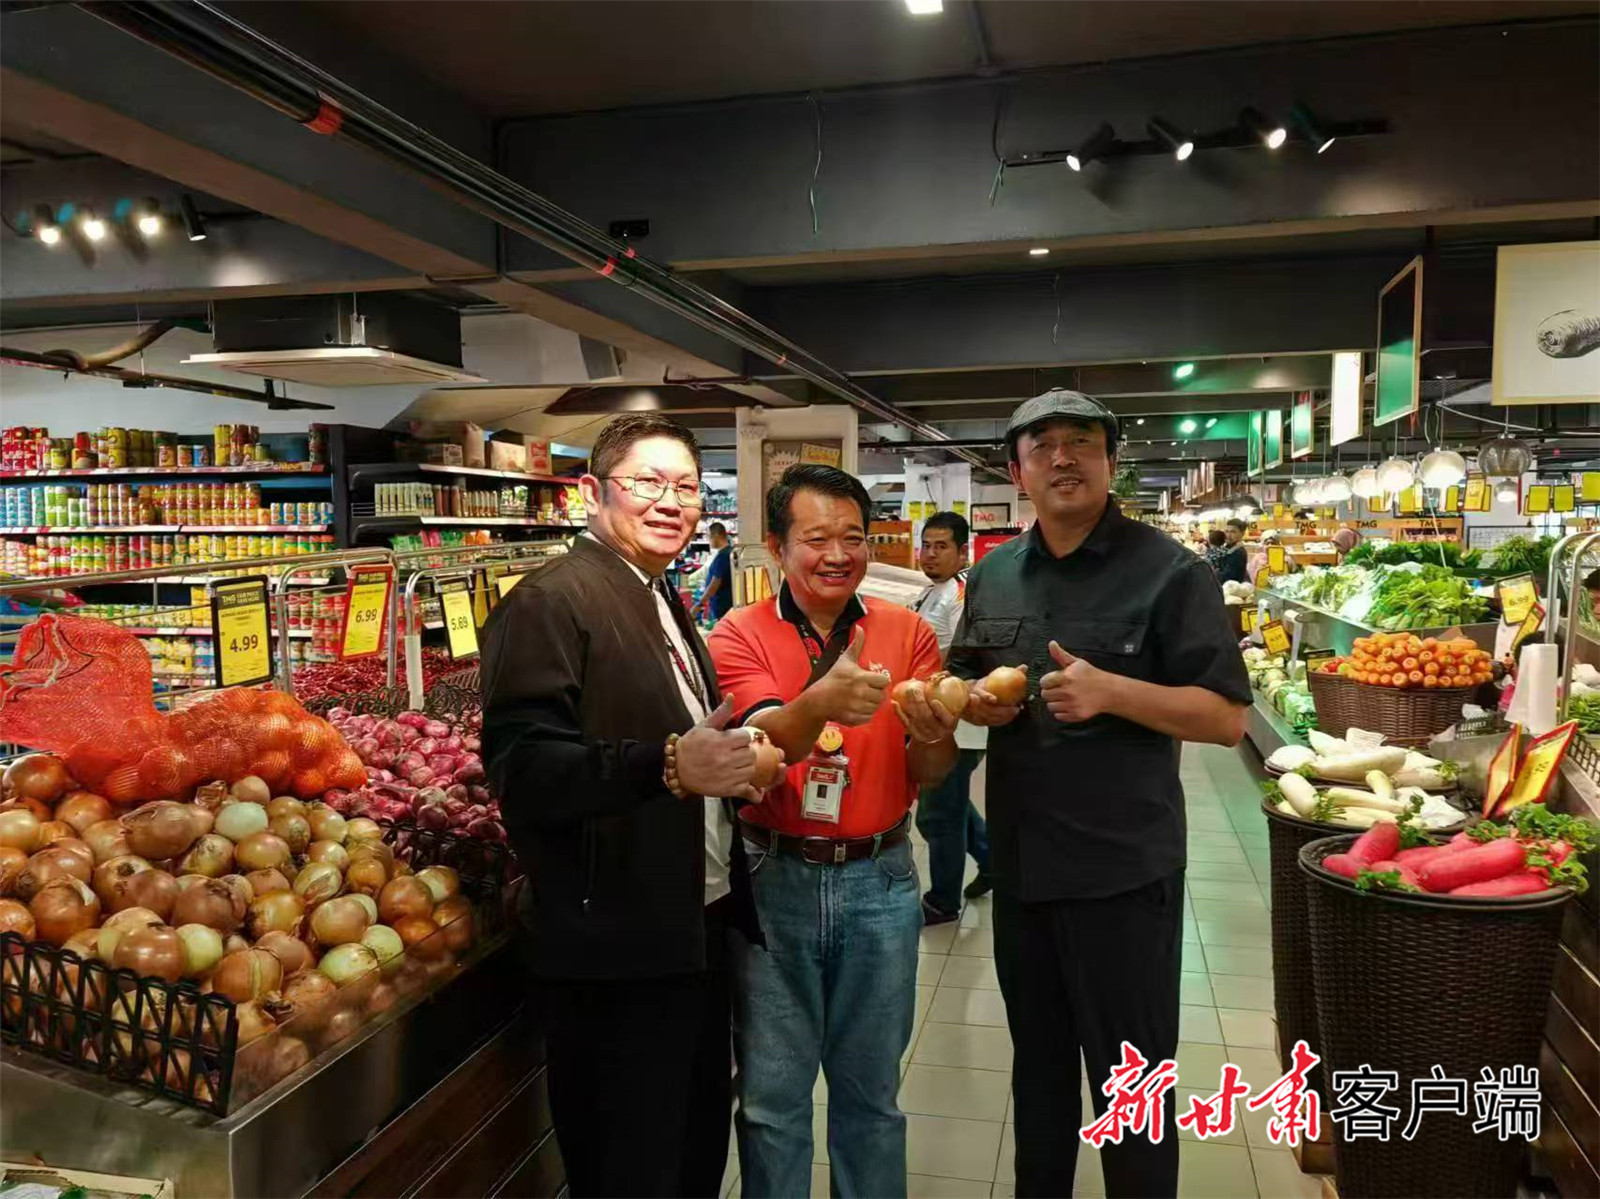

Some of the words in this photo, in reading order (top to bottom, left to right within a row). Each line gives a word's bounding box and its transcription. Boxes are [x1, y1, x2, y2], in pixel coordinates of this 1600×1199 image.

[1295, 521, 1317, 530] TMG
[1356, 520, 1377, 528] TMG
[1419, 519, 1442, 527] TMG
[1585, 517, 1600, 528] TM
[355, 608, 377, 623] 6.99
[230, 634, 259, 652] 4.99
